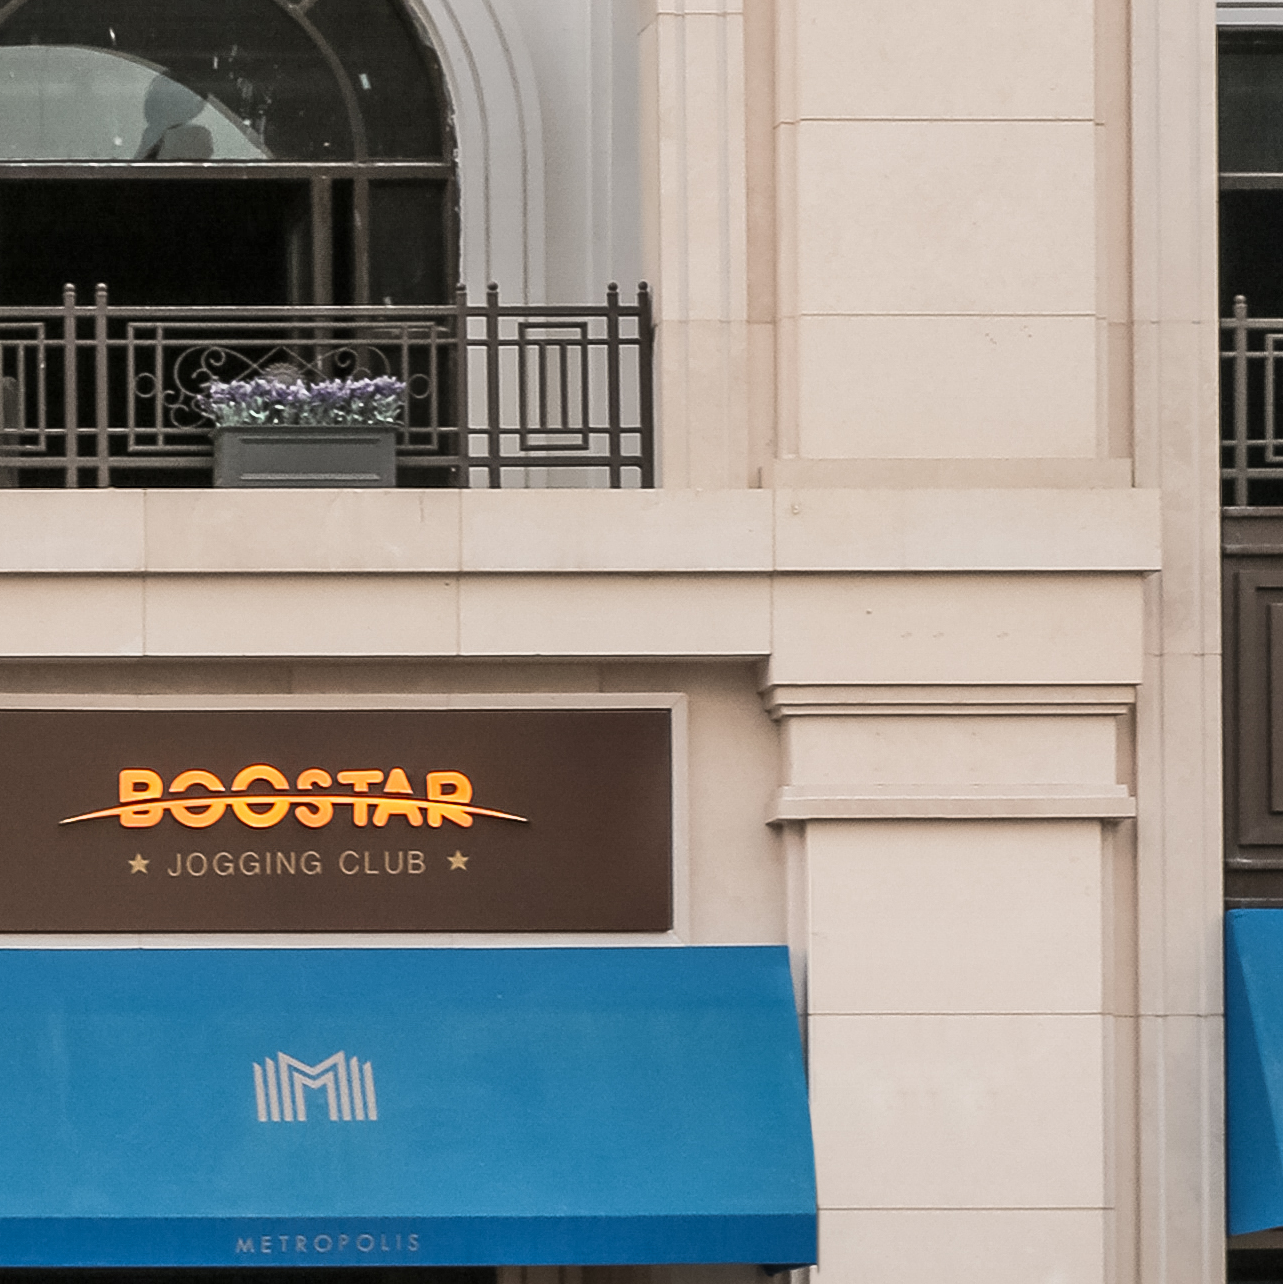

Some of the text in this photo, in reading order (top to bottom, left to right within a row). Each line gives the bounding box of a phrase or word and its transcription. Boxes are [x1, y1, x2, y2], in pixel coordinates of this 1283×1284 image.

[117, 763, 475, 828] BOOSTAR
[167, 850, 427, 877] JOGGING CLUB
[234, 1233, 421, 1255] METROPOLIS
